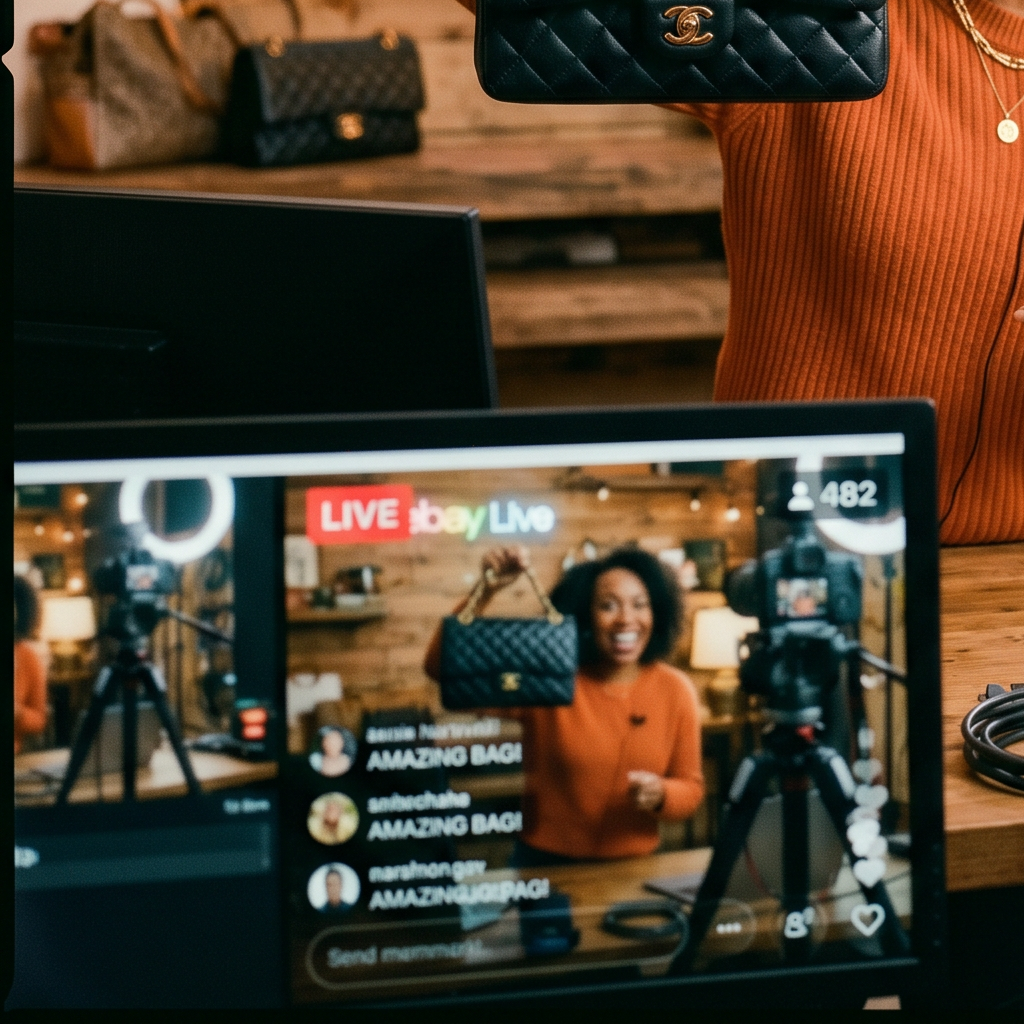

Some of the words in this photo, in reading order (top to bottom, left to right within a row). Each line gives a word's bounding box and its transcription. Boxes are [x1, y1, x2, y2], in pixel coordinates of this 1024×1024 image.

[820, 479, 878, 508] 482
[320, 498, 400, 532] LIVE
[366, 746, 468, 772] AMAZING
[366, 817, 469, 842] AMAZING
